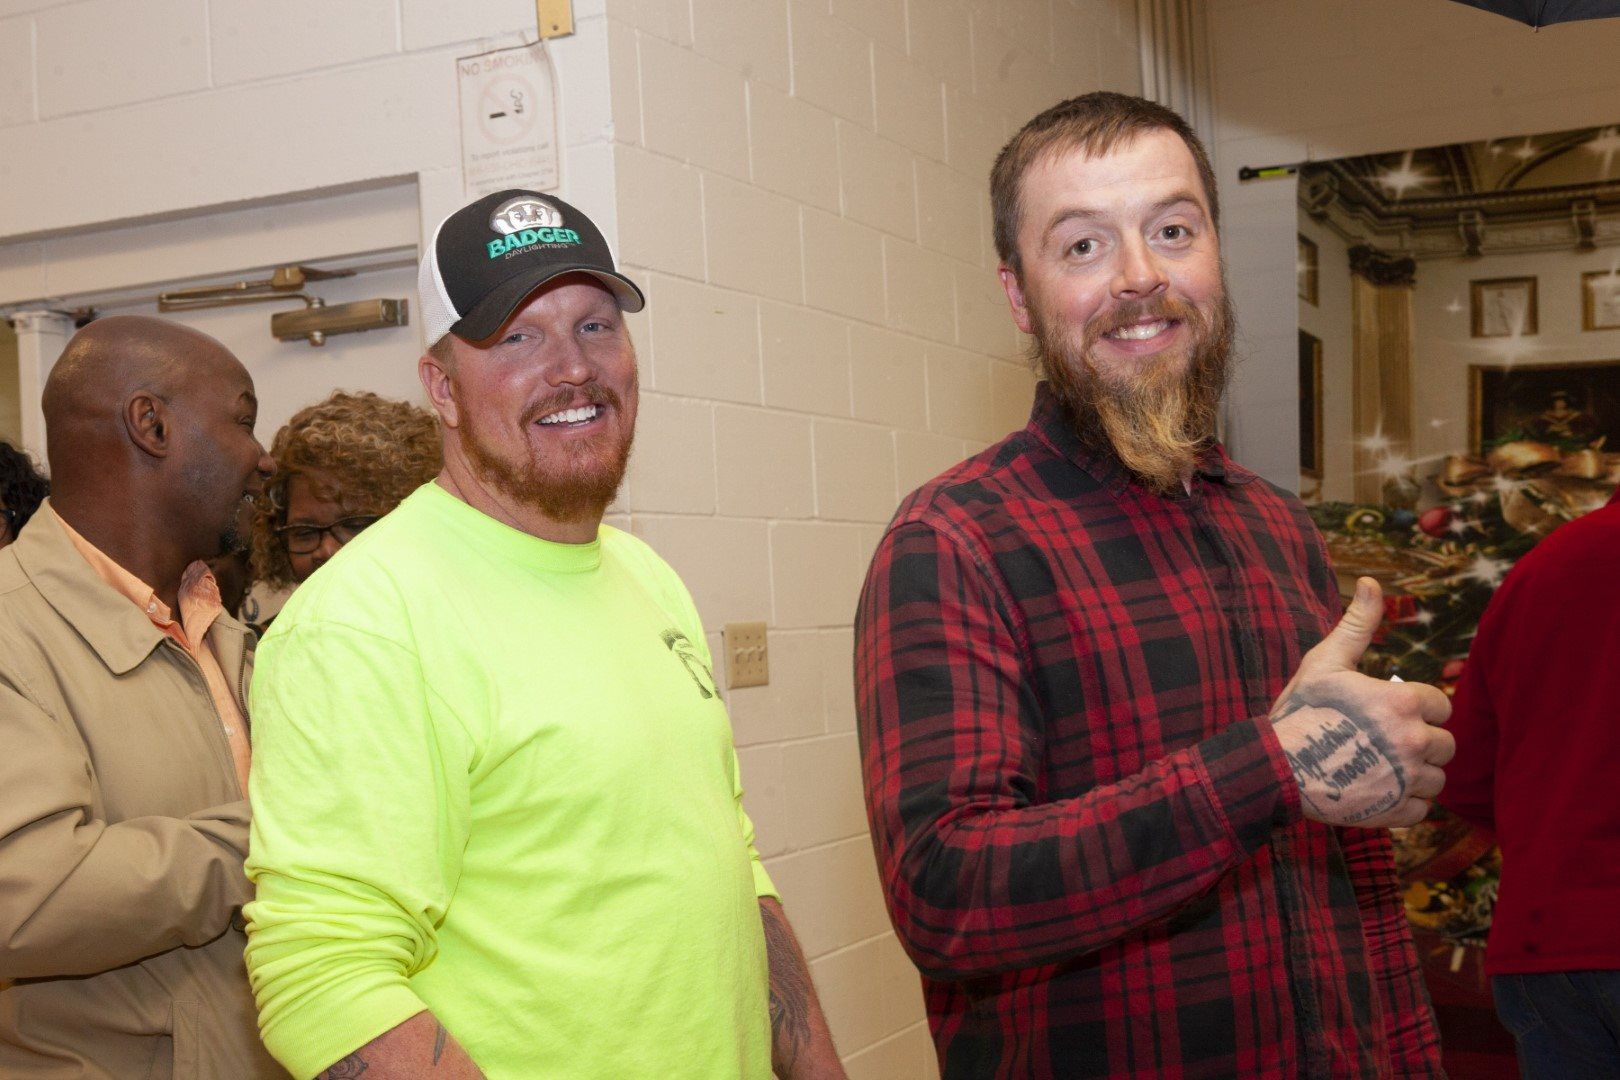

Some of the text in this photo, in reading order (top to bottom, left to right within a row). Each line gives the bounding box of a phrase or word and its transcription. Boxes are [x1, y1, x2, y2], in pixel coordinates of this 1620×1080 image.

[461, 64, 481, 77] NO
[486, 226, 583, 260] BADGER
[504, 243, 569, 260] DAYLIGHTING
